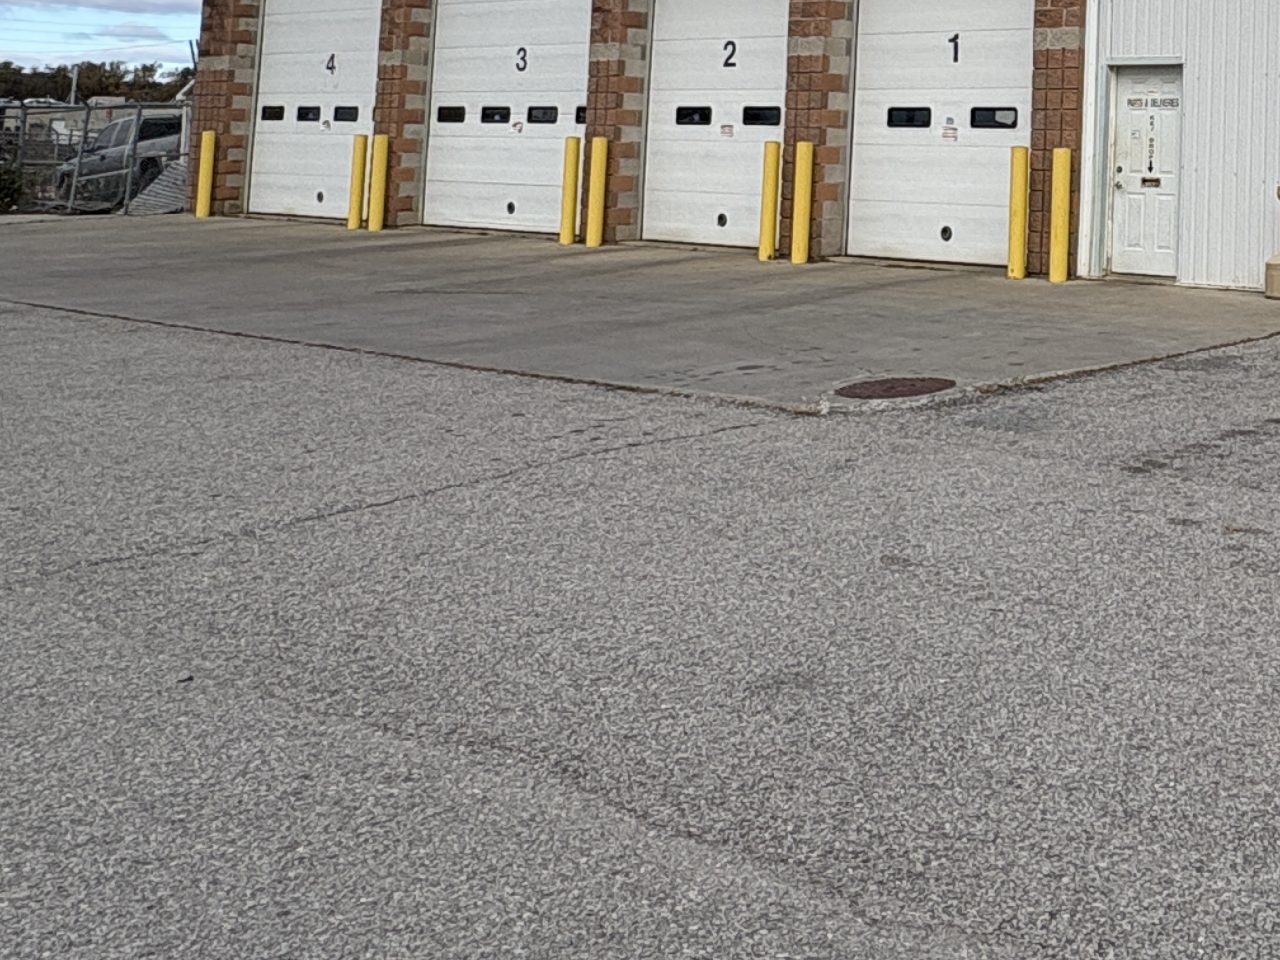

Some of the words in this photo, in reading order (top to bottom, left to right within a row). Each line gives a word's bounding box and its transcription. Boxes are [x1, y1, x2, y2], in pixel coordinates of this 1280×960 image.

[515, 47, 528, 72] 3
[723, 41, 737, 67] 2
[948, 33, 960, 63] 1
[326, 53, 337, 75] 4
